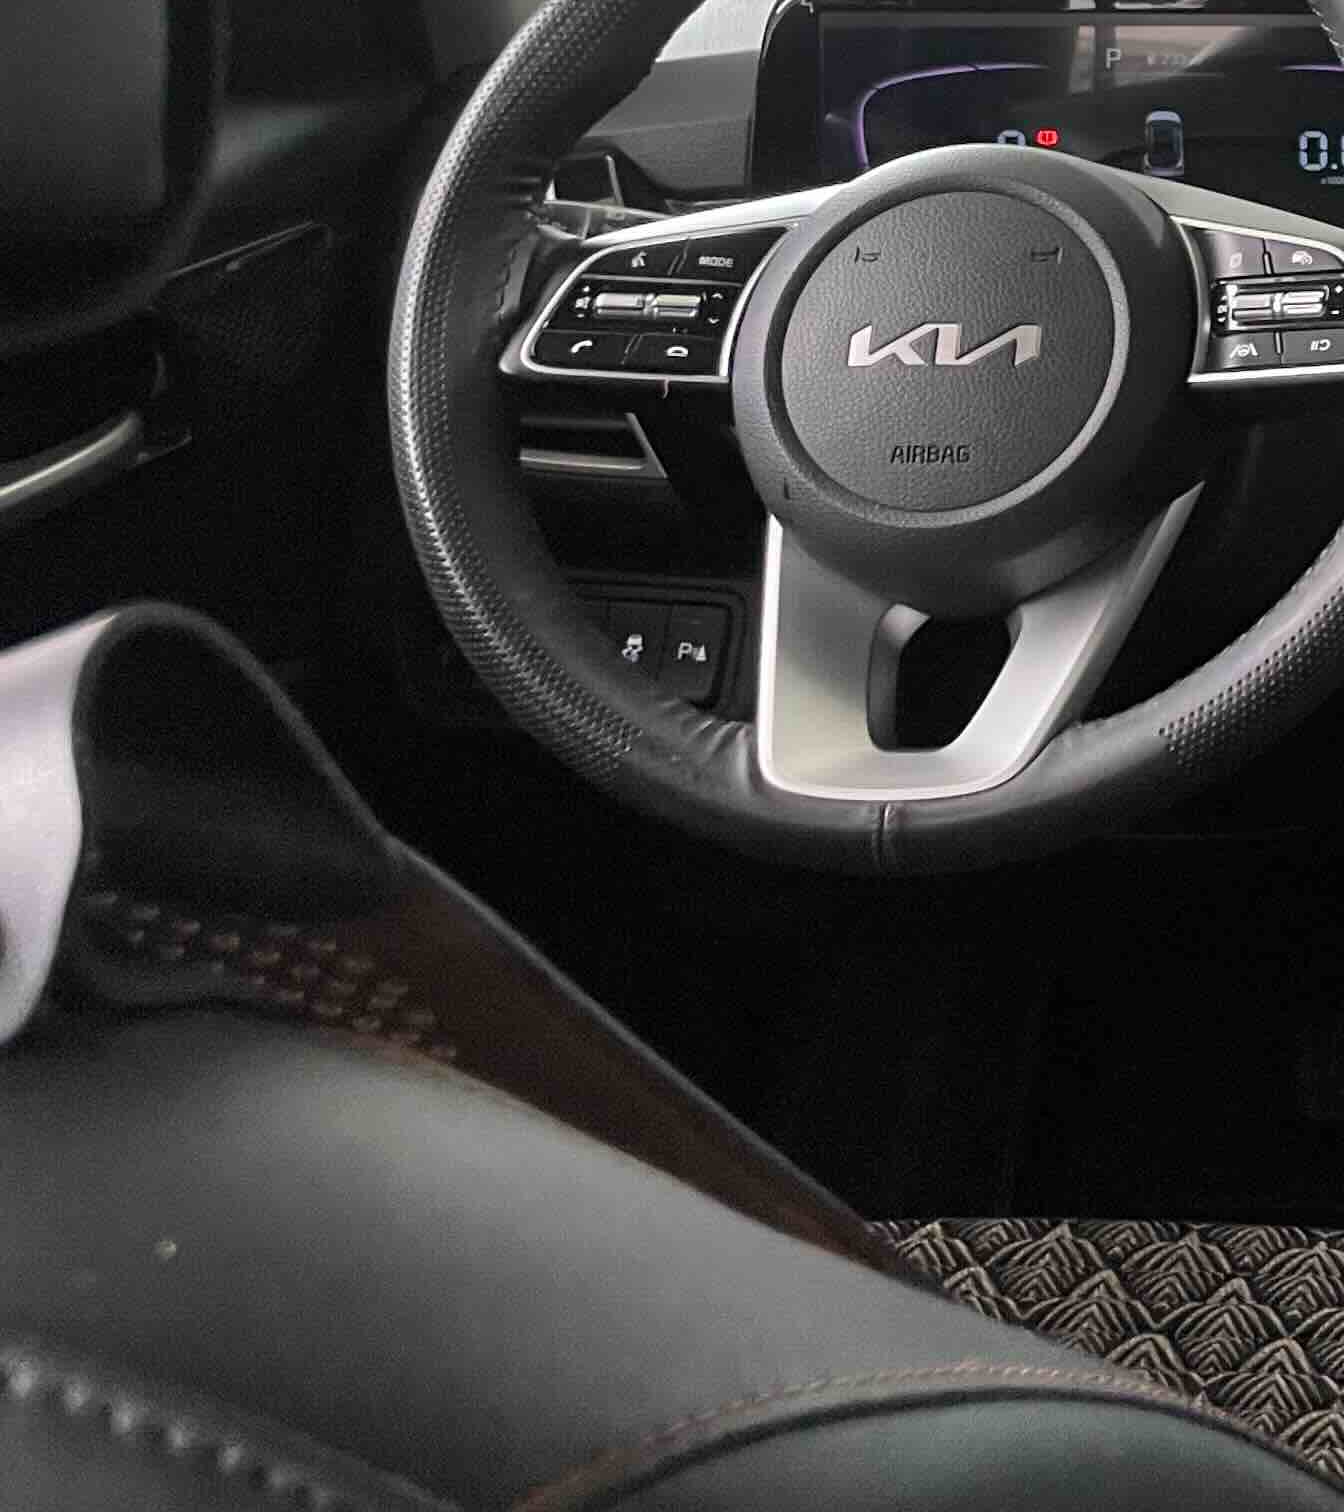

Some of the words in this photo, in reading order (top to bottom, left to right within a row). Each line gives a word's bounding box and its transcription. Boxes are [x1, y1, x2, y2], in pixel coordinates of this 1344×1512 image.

[1105, 47, 1122, 70] P
[697, 255, 735, 269] MODE
[847, 322, 1042, 368] KIA
[890, 444, 971, 465] AIRBAG
